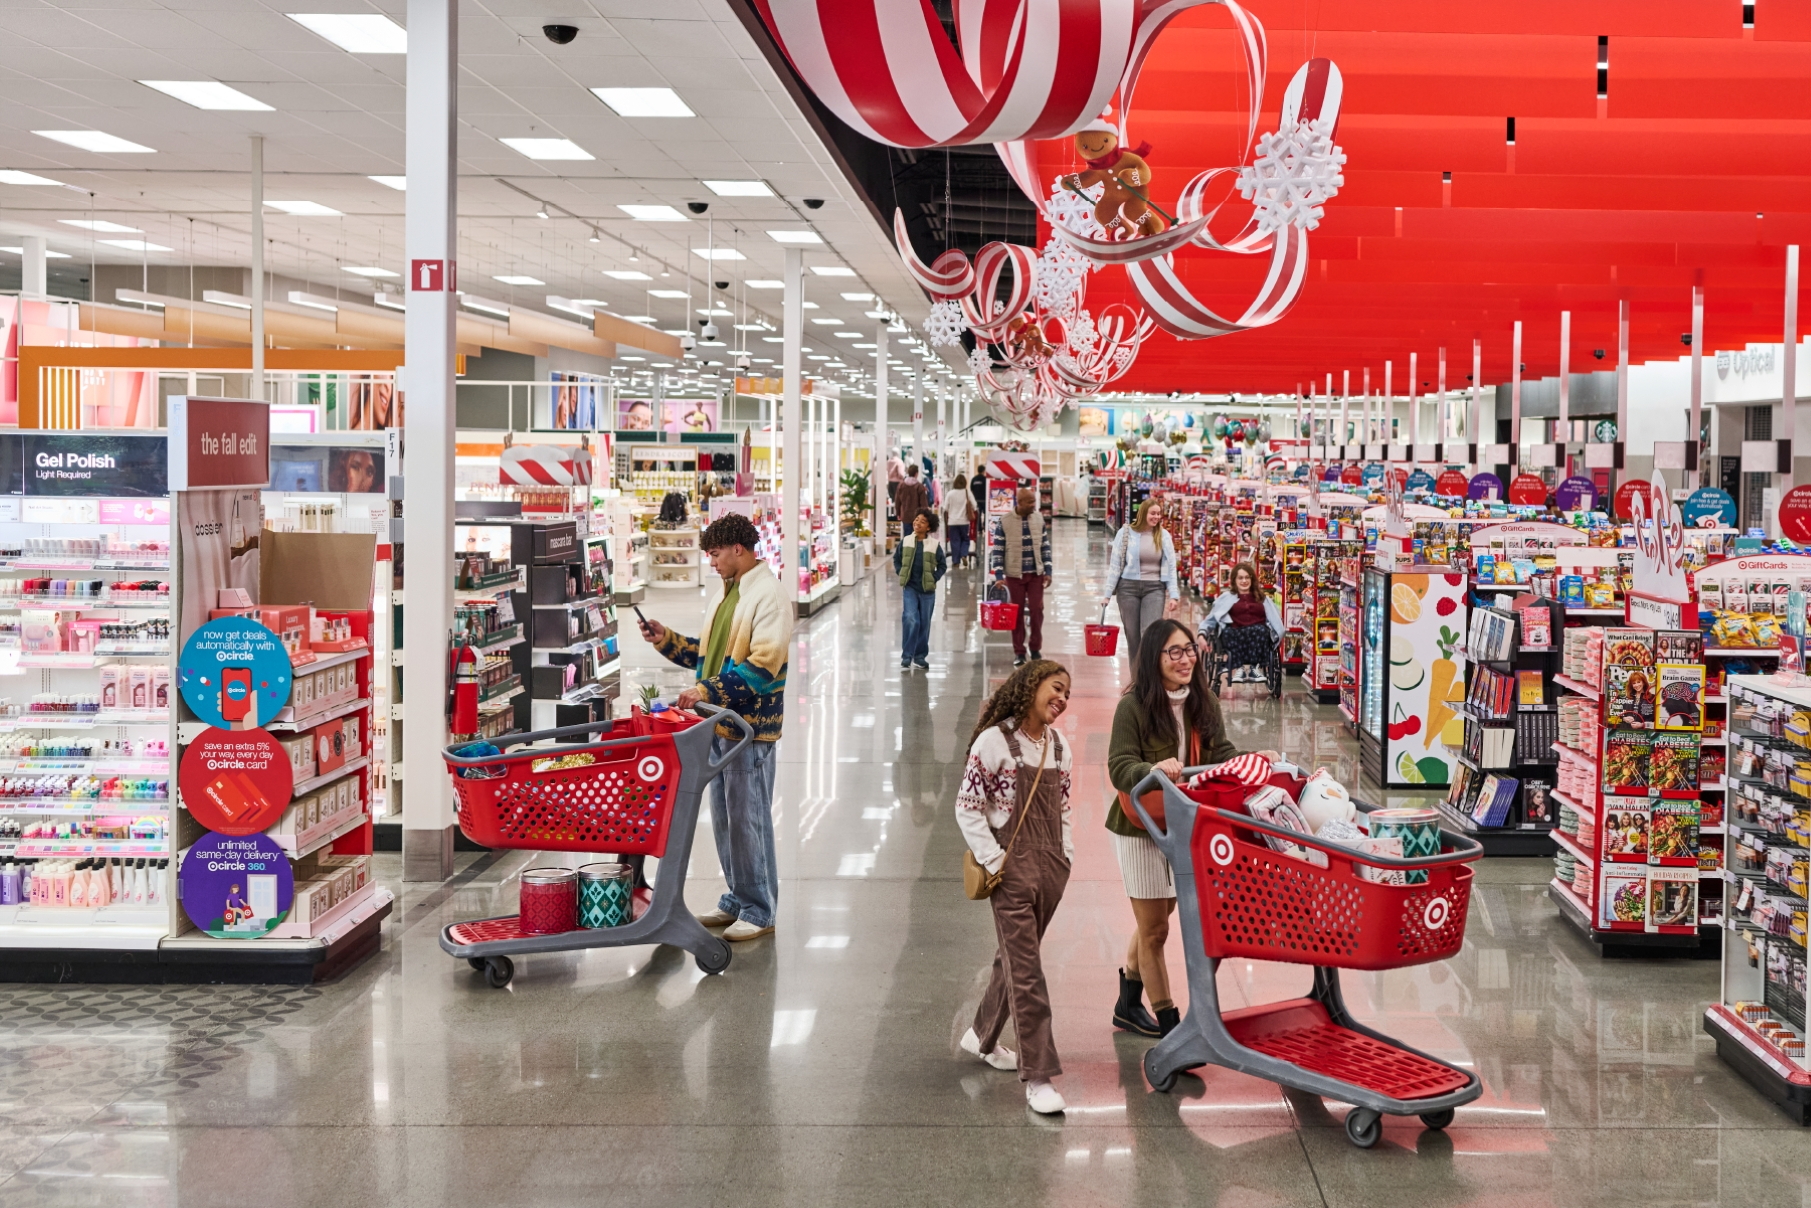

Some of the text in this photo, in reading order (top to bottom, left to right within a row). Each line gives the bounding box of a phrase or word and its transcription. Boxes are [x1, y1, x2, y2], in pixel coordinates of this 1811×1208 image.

[1733, 344, 1775, 381] Optical
[201, 432, 257, 455] the fall edit
[36, 452, 115, 468] Gel Polish
[36, 470, 91, 480] Light Required
[195, 520, 223, 536] dossier
[550, 537, 565, 549] mascara
[1748, 561, 1788, 569] GiftCards
[203, 630, 267, 641] now get deals
[196, 641, 275, 652] automatically with
[1672, 649, 1686, 658] THE
[1611, 737, 1650, 745] DIABETES
[200, 751, 274, 760] your way, every day
[246, 760, 267, 769] card
[218, 841, 256, 850] unlimited
[196, 850, 241, 860] same-day
[218, 861, 265, 870] circle 360
